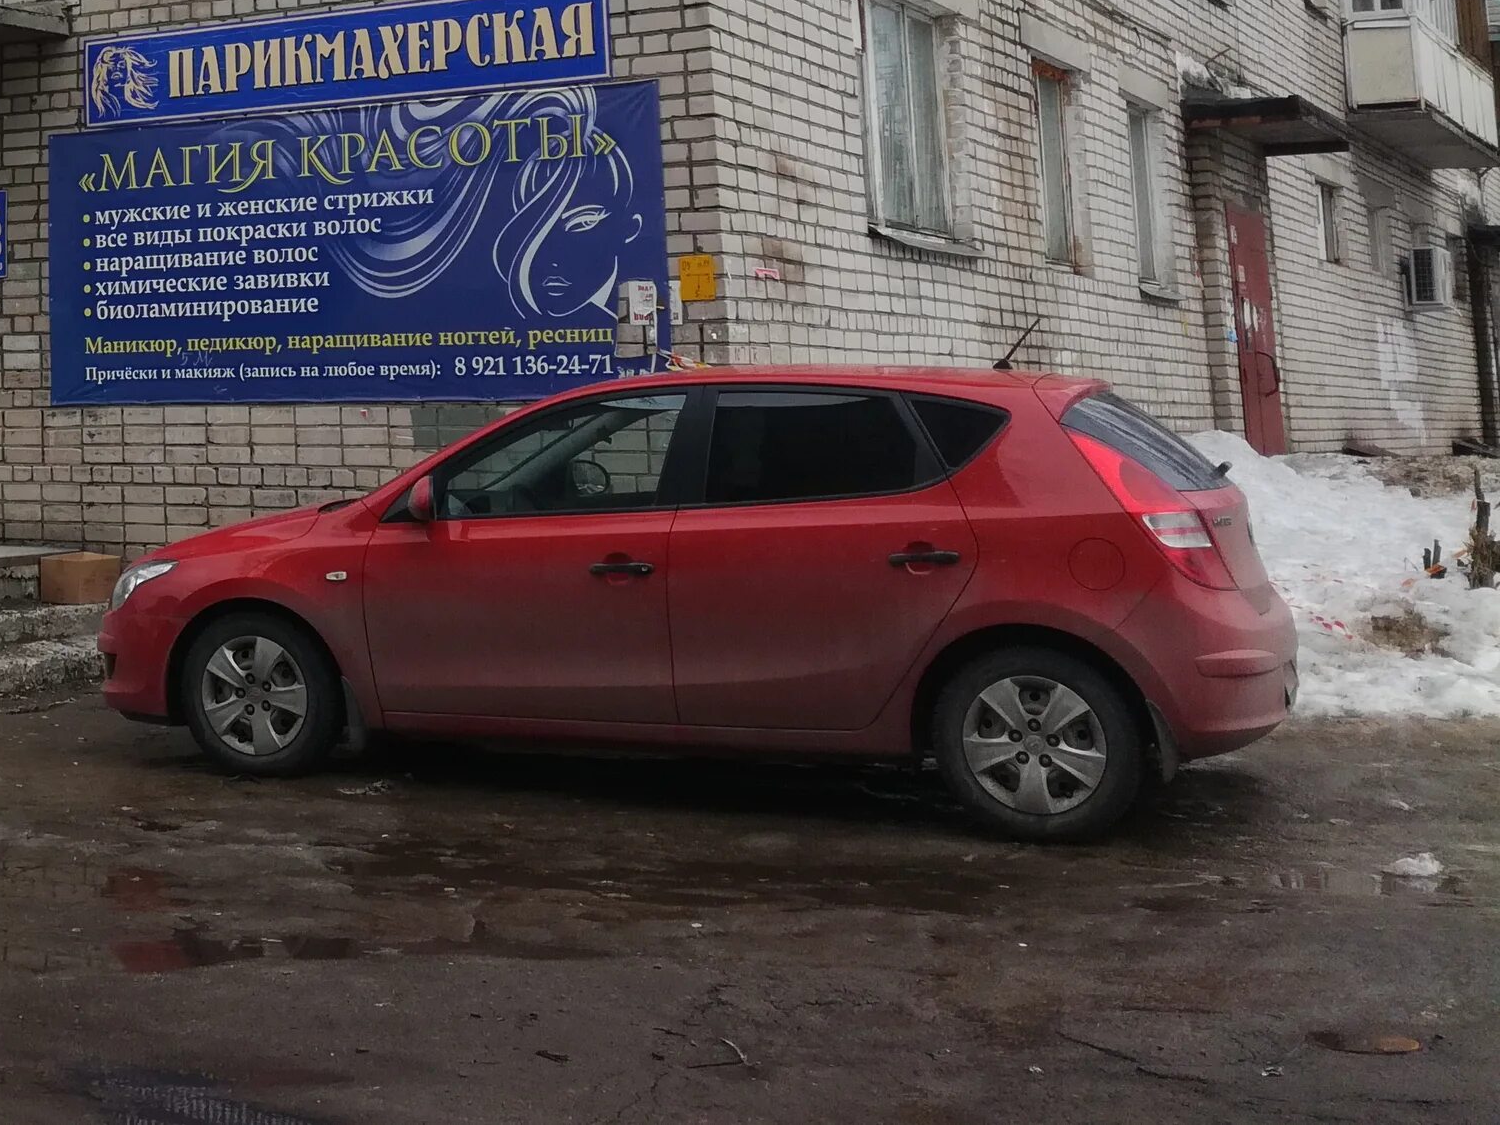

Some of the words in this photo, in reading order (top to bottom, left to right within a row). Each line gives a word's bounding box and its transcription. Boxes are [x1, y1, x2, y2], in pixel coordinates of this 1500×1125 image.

[168, 1, 596, 97] ПАРИКМАХЕРСКАЯ
[78, 139, 276, 194] «МАГИЯ
[298, 114, 617, 187] КРАСОТЫ»
[95, 204, 191, 230] мужские
[197, 203, 211, 218] и
[217, 195, 317, 217] женские
[324, 188, 434, 215] стрижки
[95, 233, 127, 248] все
[133, 228, 192, 248] виды
[198, 222, 307, 246] покраски
[314, 217, 381, 236] волос
[95, 250, 247, 276] наращивание
[252, 246, 318, 265] волос
[95, 276, 228, 296] химические
[233, 271, 330, 290] завивки
[96, 297, 319, 322] биоламинирование
[85, 337, 182, 357] Маникюр,
[187, 335, 282, 356] педикюр,
[287, 332, 432, 355] наращивание
[439, 327, 522, 348] ногтей,
[528, 328, 614, 350] ресниц
[85, 366, 157, 384] Причёски
[161, 368, 171, 379] и
[175, 366, 235, 379] макияж
[240, 363, 296, 381] (запись
[301, 366, 319, 377] на
[323, 361, 376, 377] любое
[380, 360, 441, 380] время):
[454, 357, 467, 375] 8
[472, 356, 504, 376] 921
[513, 354, 614, 376] 136-24-71
